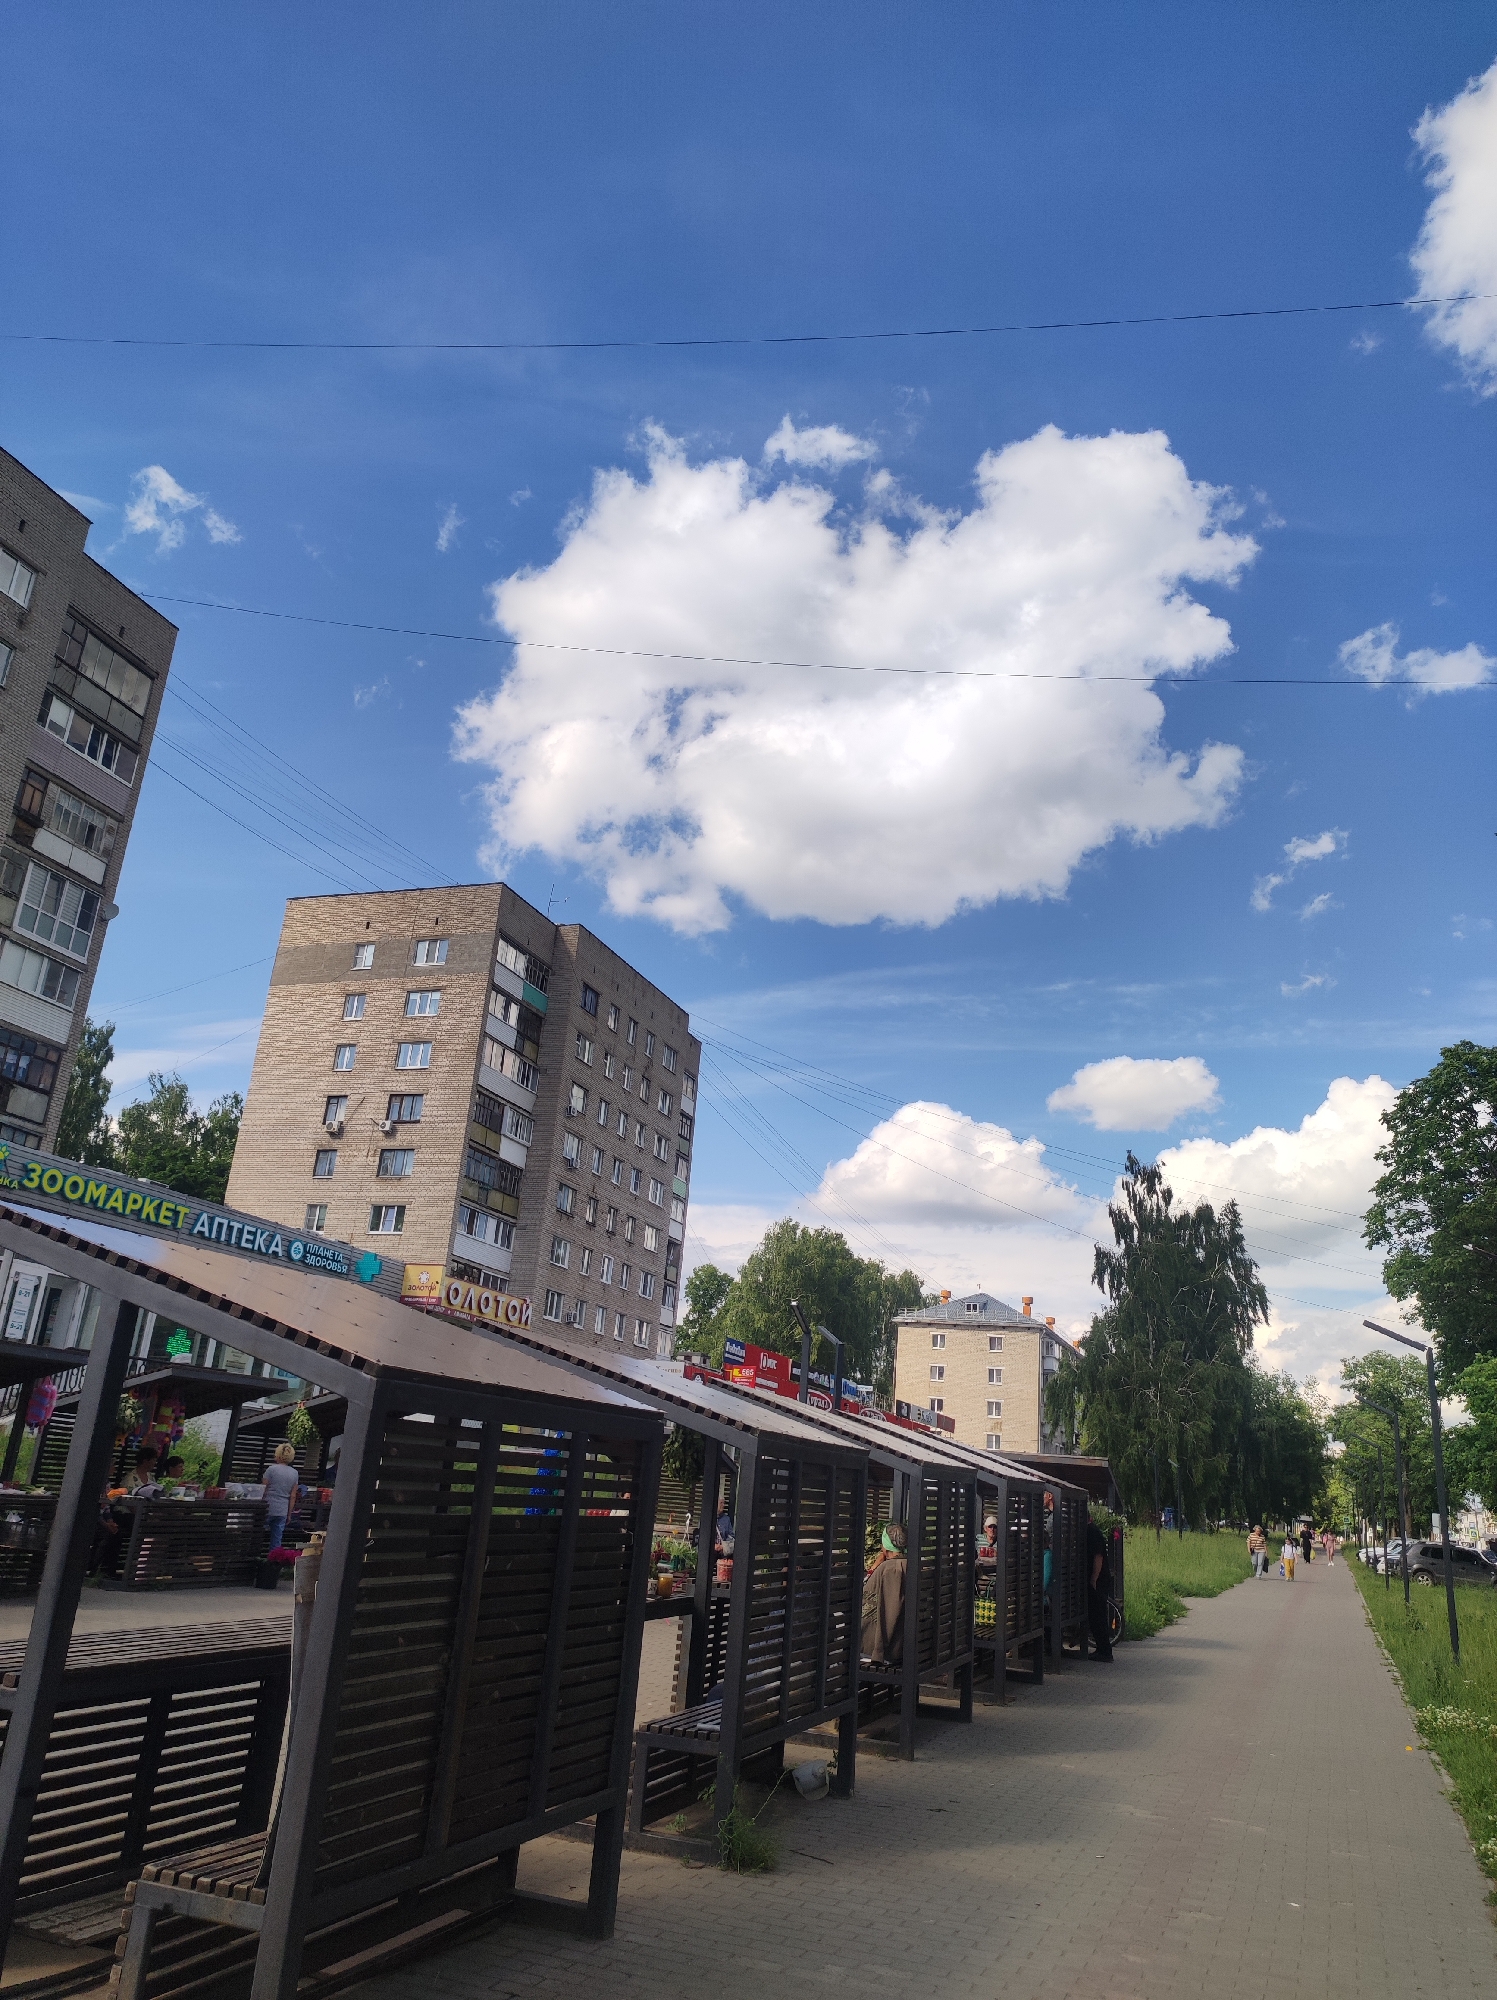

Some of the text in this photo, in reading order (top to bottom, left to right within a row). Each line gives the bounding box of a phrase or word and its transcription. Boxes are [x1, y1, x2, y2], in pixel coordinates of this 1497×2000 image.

[23, 1162, 190, 1229] ЗООМАРКЕТ
[192, 1211, 284, 1257] АПТЕКА
[305, 1243, 344, 1263] ПЛАНЕТА
[304, 1254, 348, 1275] ЗДОРОВЬЯ
[442, 1280, 533, 1326] ОЛОТОЙ
